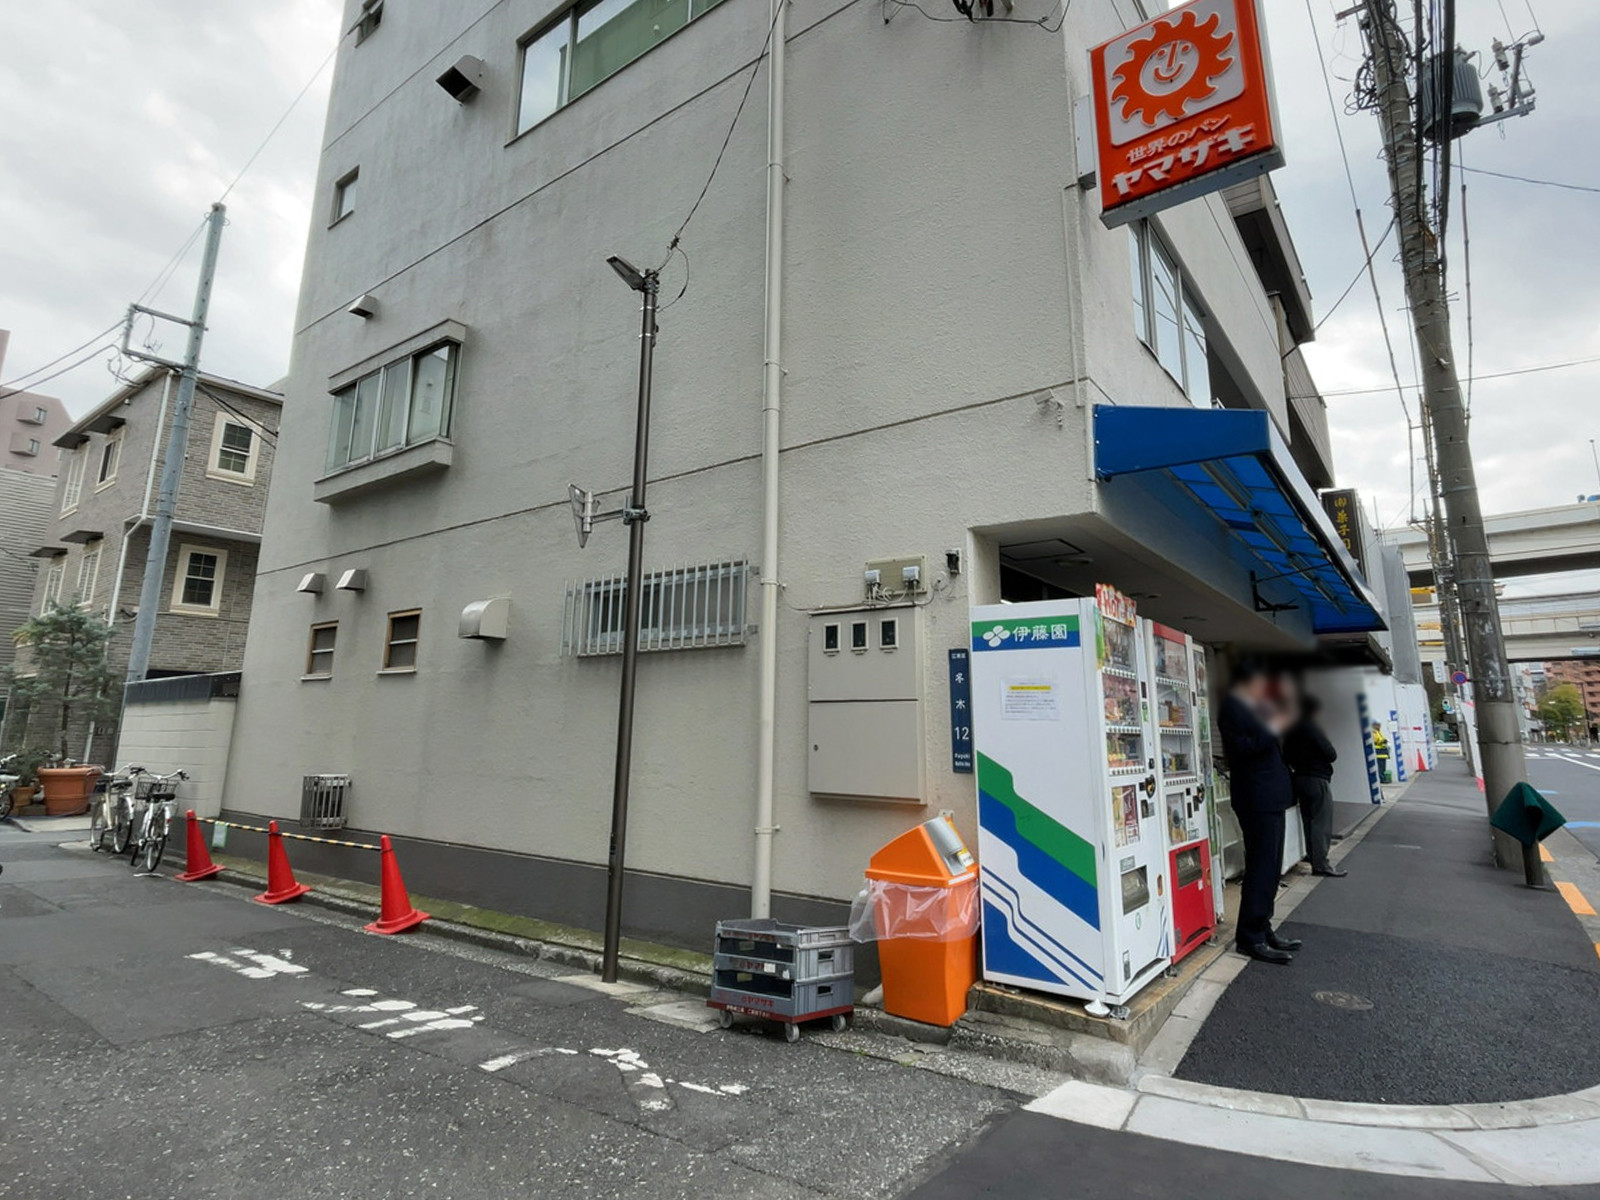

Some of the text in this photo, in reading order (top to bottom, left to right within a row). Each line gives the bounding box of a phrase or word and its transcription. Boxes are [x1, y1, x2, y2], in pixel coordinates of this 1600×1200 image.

[1113, 123, 1255, 195] ヤマザキ
[1127, 115, 1230, 164] 世界のパン
[1012, 623, 1068, 642] 伊藤園
[954, 672, 970, 740] 冬木 12
